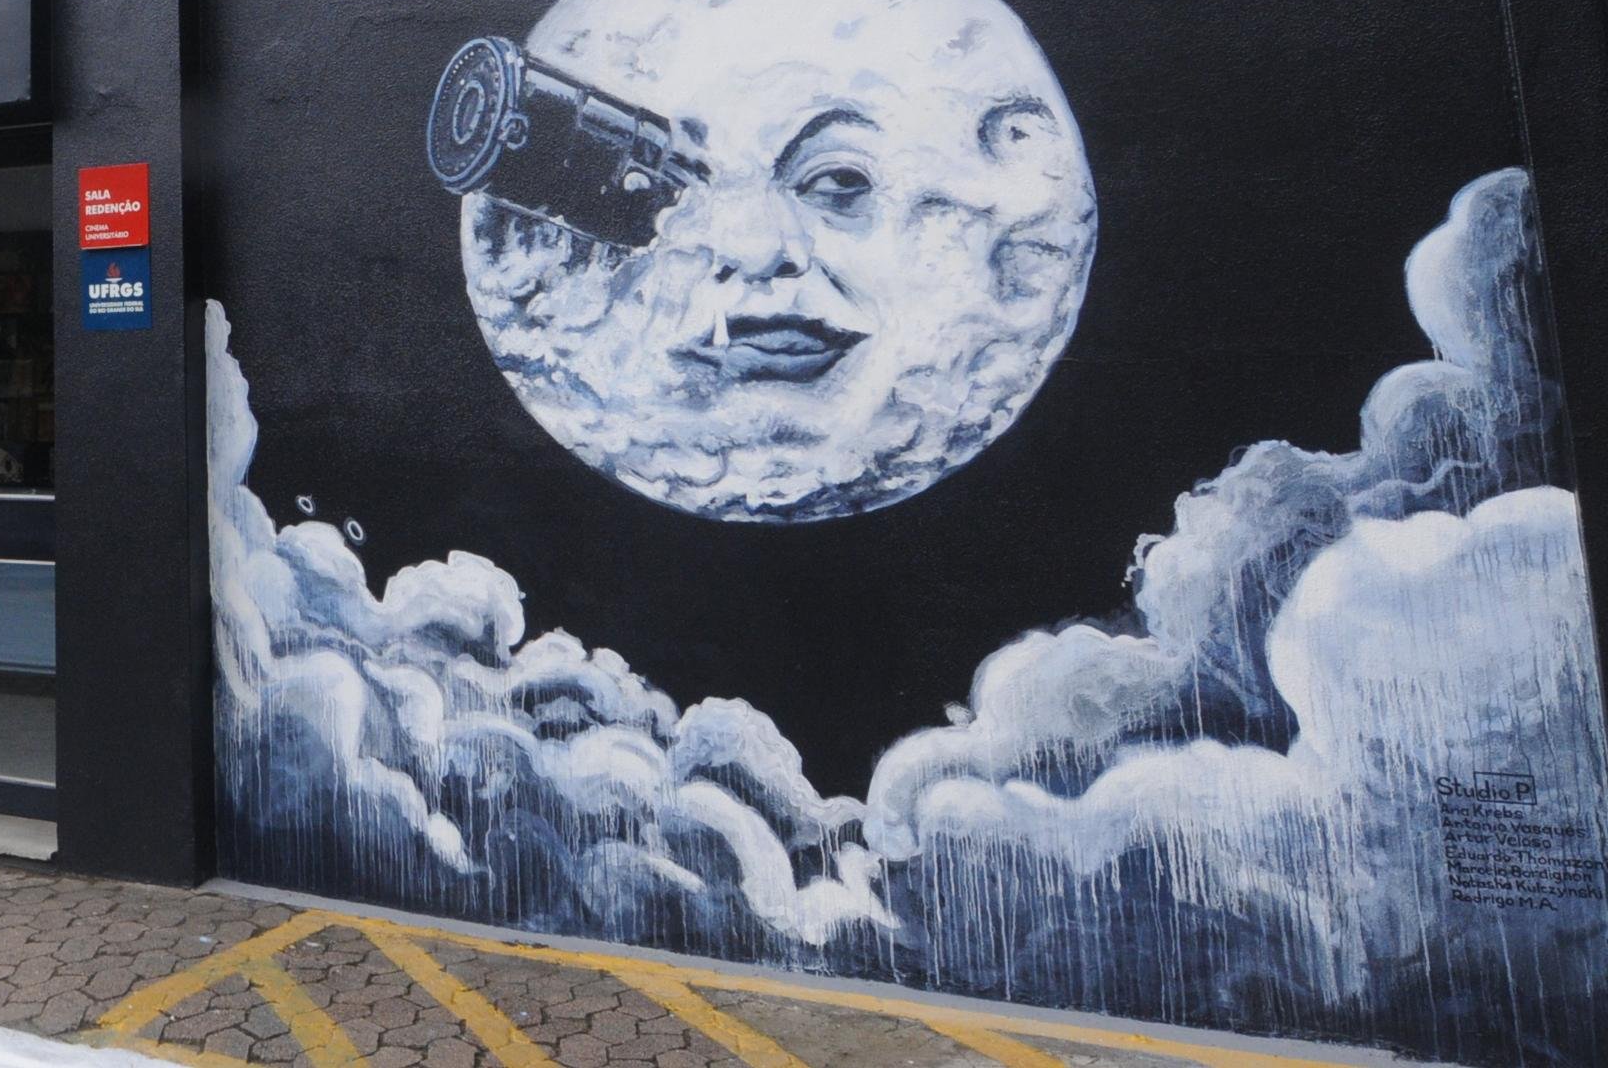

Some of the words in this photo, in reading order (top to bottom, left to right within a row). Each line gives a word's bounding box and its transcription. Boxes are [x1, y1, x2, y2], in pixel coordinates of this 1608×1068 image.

[85, 189, 111, 201] SALA
[85, 199, 141, 216] REDENÇÃO
[85, 224, 109, 232] CINEMA
[88, 281, 144, 299] UFRGS
[1436, 777, 1510, 800] Studio
[1515, 781, 1531, 801] P
[1440, 803, 1470, 817] Ana
[1472, 803, 1524, 820] Krebs
[1442, 817, 1508, 832] Antonio
[1444, 831, 1492, 844] Artur
[1495, 832, 1552, 849] Veloso
[1445, 845, 1512, 863] Eduardo
[1452, 889, 1514, 909] Rodrigo
